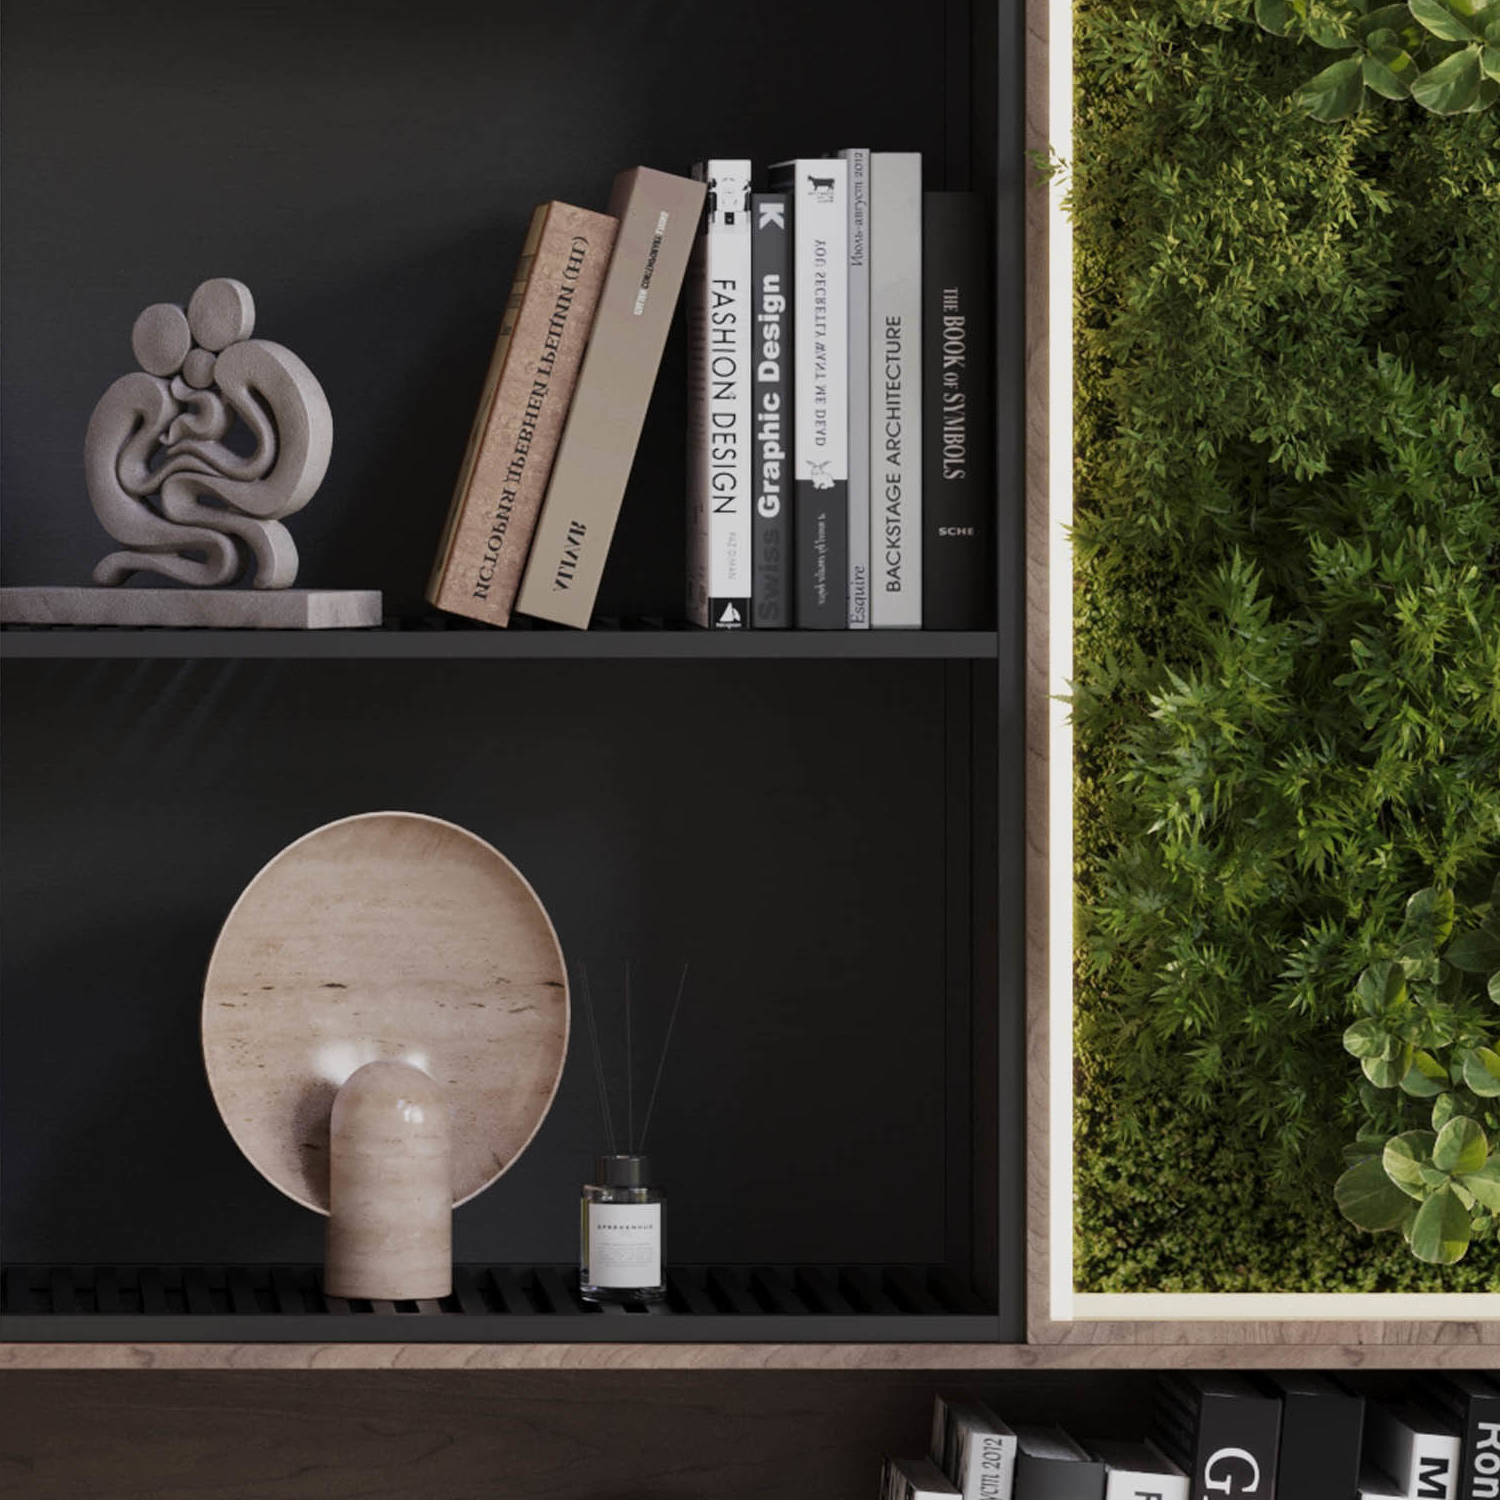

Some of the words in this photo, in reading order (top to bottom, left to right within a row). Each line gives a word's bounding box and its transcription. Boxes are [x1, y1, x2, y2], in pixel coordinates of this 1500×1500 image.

[853, 151, 863, 178] 2012
[711, 279, 736, 400] FASHION
[758, 274, 786, 382] Design
[942, 315, 966, 370] BOOK
[943, 287, 958, 313] THE
[885, 315, 902, 468] ARCHITECTURE
[943, 372, 959, 390] OF
[711, 413, 737, 514] DESIGN
[758, 392, 786, 518] Graphic
[942, 392, 966, 480] SYMBOLS
[758, 527, 780, 621] Swiss
[885, 472, 902, 592] BACKSTAGE
[938, 526, 975, 537] SCHE
[849, 565, 866, 629] Esquire
[982, 1438, 1002, 1469] 2012
